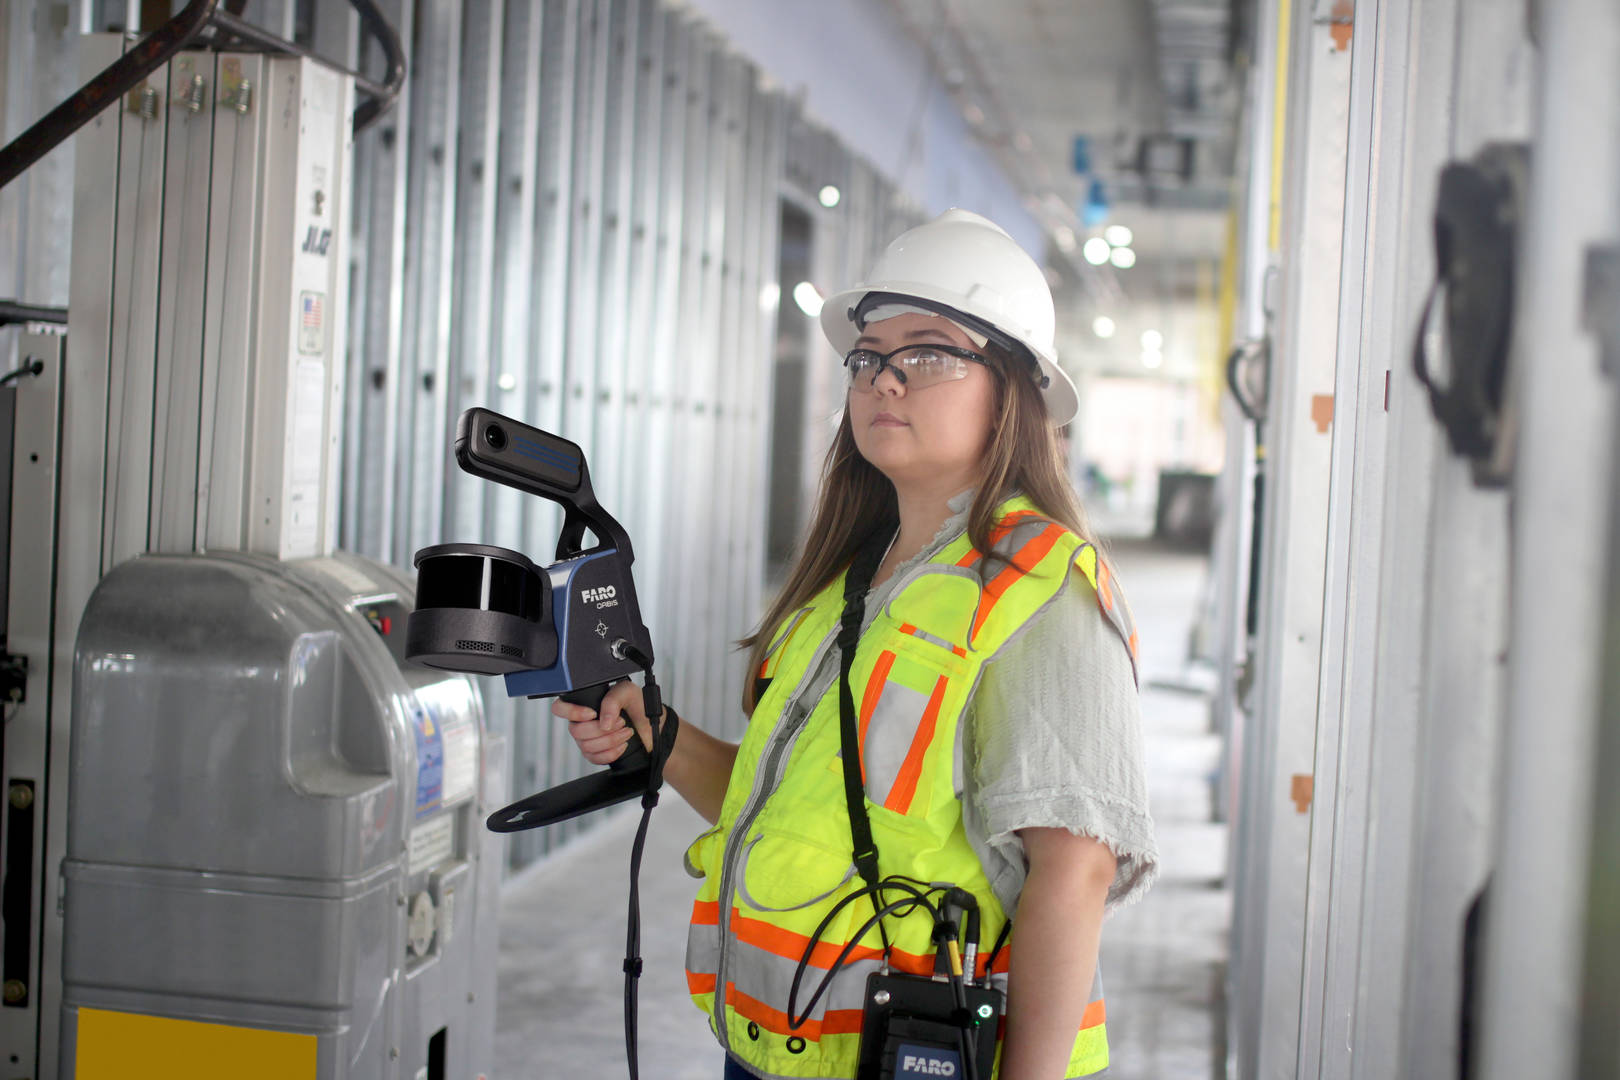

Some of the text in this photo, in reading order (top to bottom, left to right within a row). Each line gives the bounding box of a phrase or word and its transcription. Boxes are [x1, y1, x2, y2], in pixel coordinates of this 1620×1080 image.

[581, 585, 616, 604] FARO
[596, 599, 618, 609] ORBIS
[903, 1055, 955, 1077] FARO
